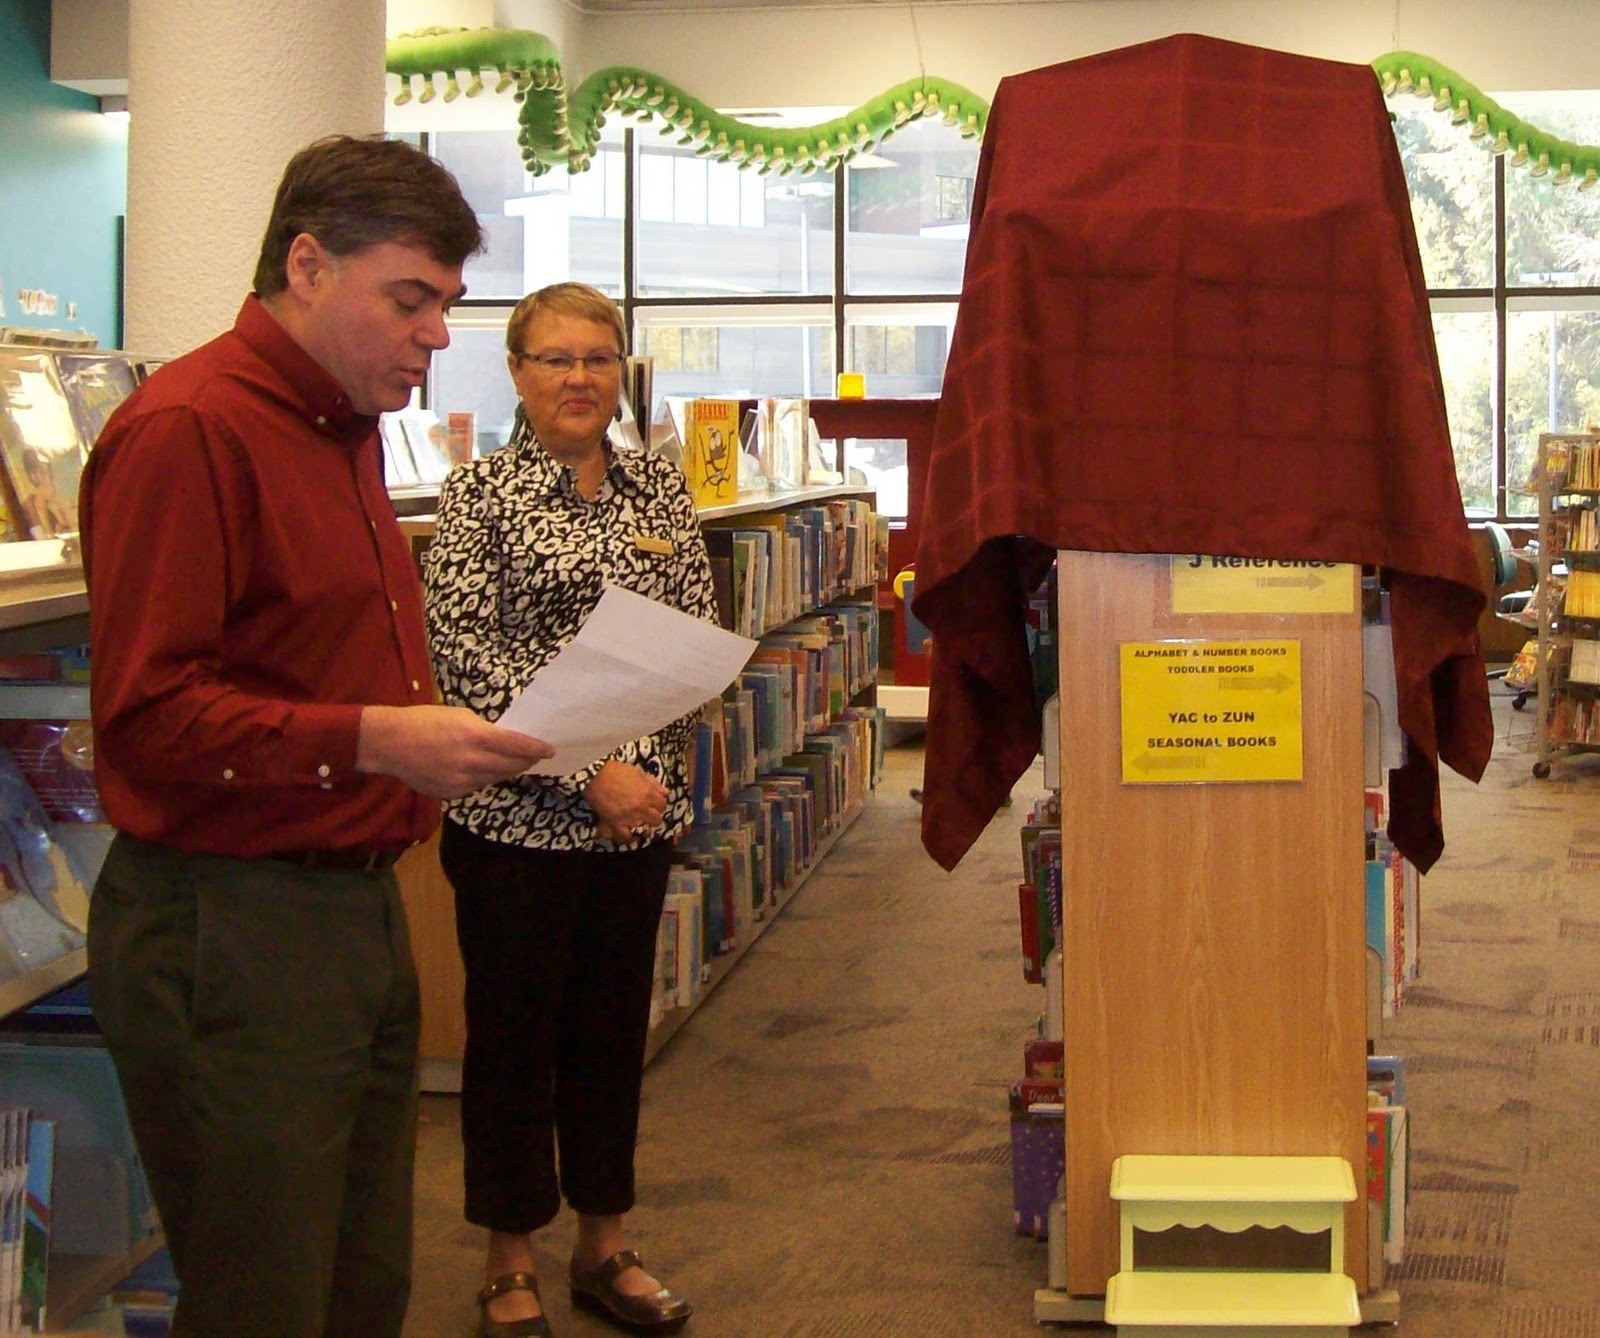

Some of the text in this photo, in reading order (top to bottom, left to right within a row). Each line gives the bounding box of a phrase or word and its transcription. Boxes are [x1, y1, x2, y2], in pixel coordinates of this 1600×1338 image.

[1134, 649, 1189, 658] ALPHABET
[1203, 648, 1248, 657] NUMBER
[1250, 647, 1287, 656] BOOKS
[1167, 665, 1255, 674] TODDLER BOOKS
[1168, 712, 1255, 724] YAC to ZUN
[1147, 737, 1277, 748] SEASONAL BOOKS
